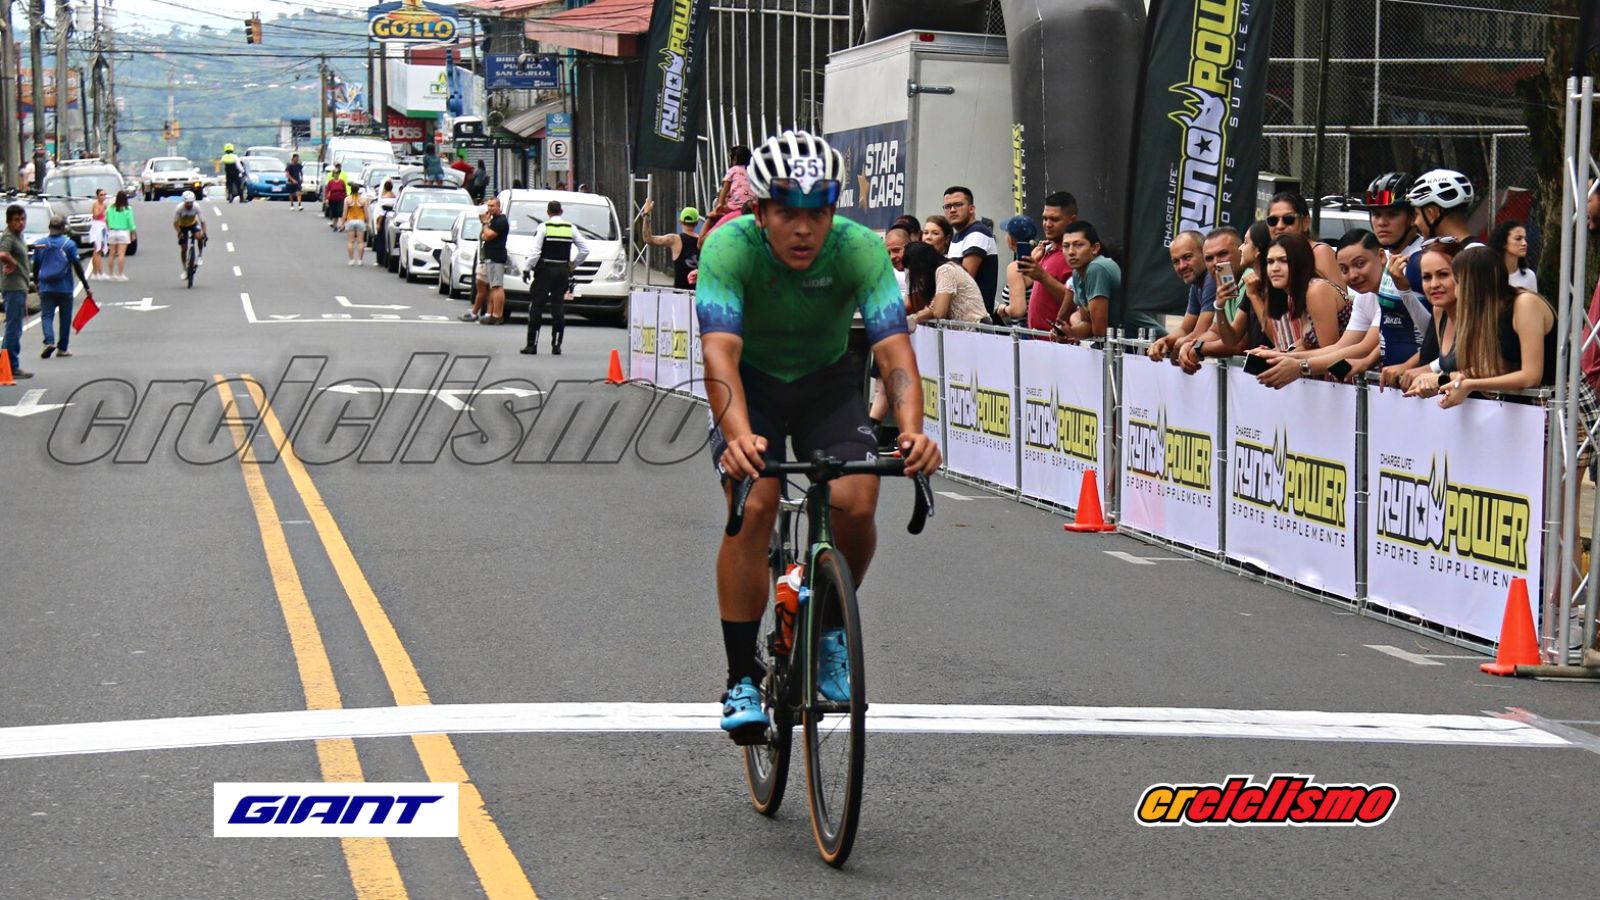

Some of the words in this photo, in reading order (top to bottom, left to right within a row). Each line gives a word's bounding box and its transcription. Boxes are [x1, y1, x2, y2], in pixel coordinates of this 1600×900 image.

[375, 18, 453, 38] GOLLO
[660, 71, 683, 139] RYNO
[388, 127, 422, 139] ROSS
[555, 143, 563, 154] E
[794, 159, 819, 178] 55
[865, 140, 898, 176] STAR
[868, 172, 904, 208] CARS
[1163, 198, 1174, 248] CHARGE
[1169, 169, 1178, 196] LIFE
[1221, 156, 1235, 223] ORTS
[977, 390, 1010, 437] POWER
[1057, 406, 1097, 462] POWER
[1052, 455, 1098, 478] SUPPLEMES
[1127, 420, 1157, 475] RYNO
[1165, 430, 1211, 490] POWER
[1380, 453, 1401, 467] CHARGE
[1401, 458, 1413, 470] LIFE
[1127, 476, 1151, 493] SPORTS
[1157, 484, 1211, 508] SUPPLEMENTS
[1233, 441, 1273, 507] RYNO
[1283, 454, 1346, 528] POWER
[1232, 502, 1265, 524] SPORTS
[1273, 515, 1346, 548] SUPPLEMENTS
[1377, 471, 1430, 546] RYNO
[1442, 486, 1529, 571] POWER
[1376, 541, 1419, 565] SPORTS
[1430, 555, 1518, 589] SUPPLEMEN
